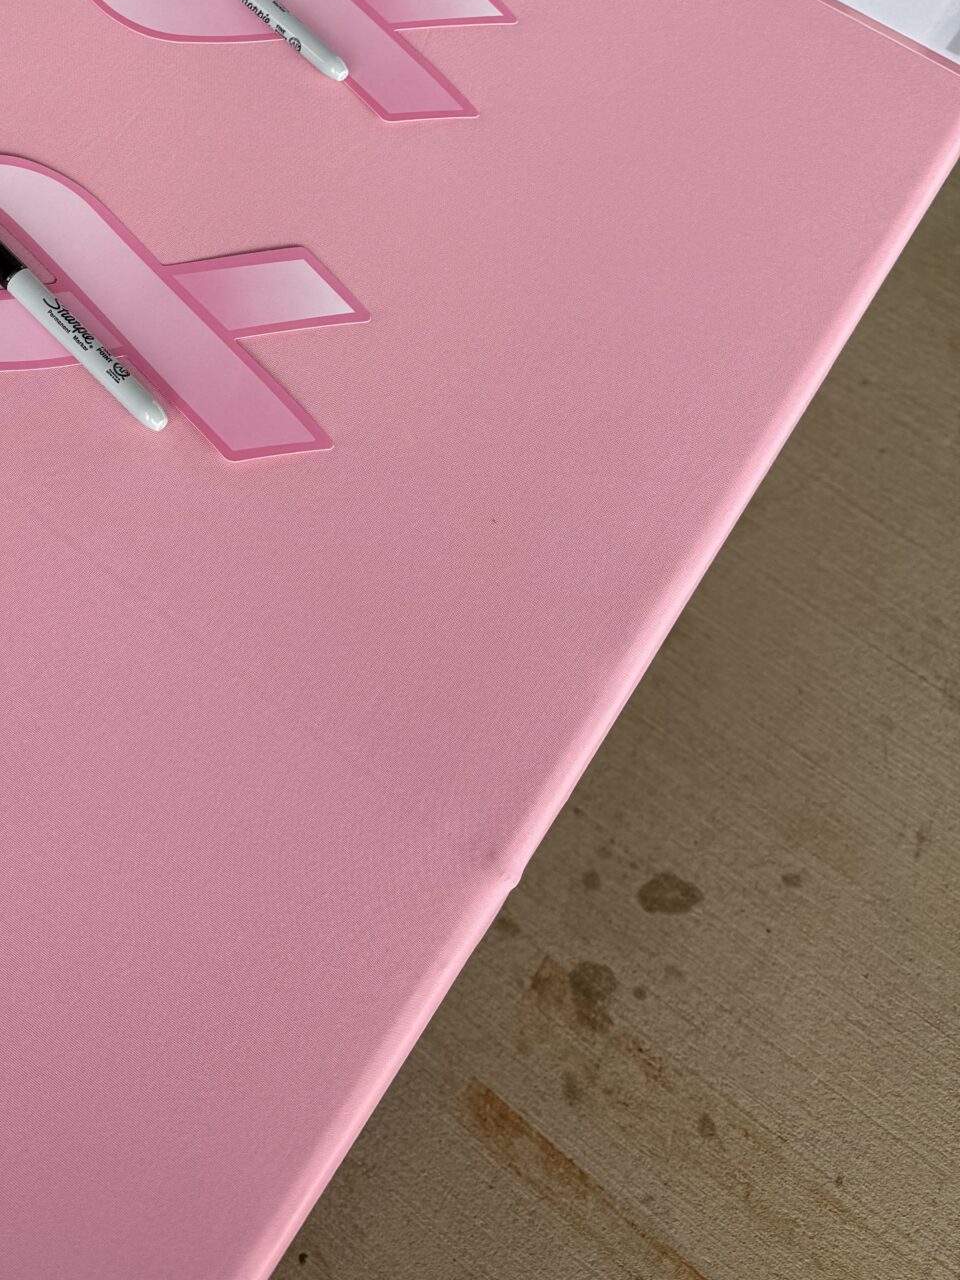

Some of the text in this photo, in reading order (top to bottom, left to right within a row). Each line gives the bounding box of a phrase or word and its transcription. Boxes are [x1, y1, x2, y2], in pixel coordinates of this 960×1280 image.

[48, 309, 88, 351] Permanent Marker
[96, 348, 112, 363] POINT
